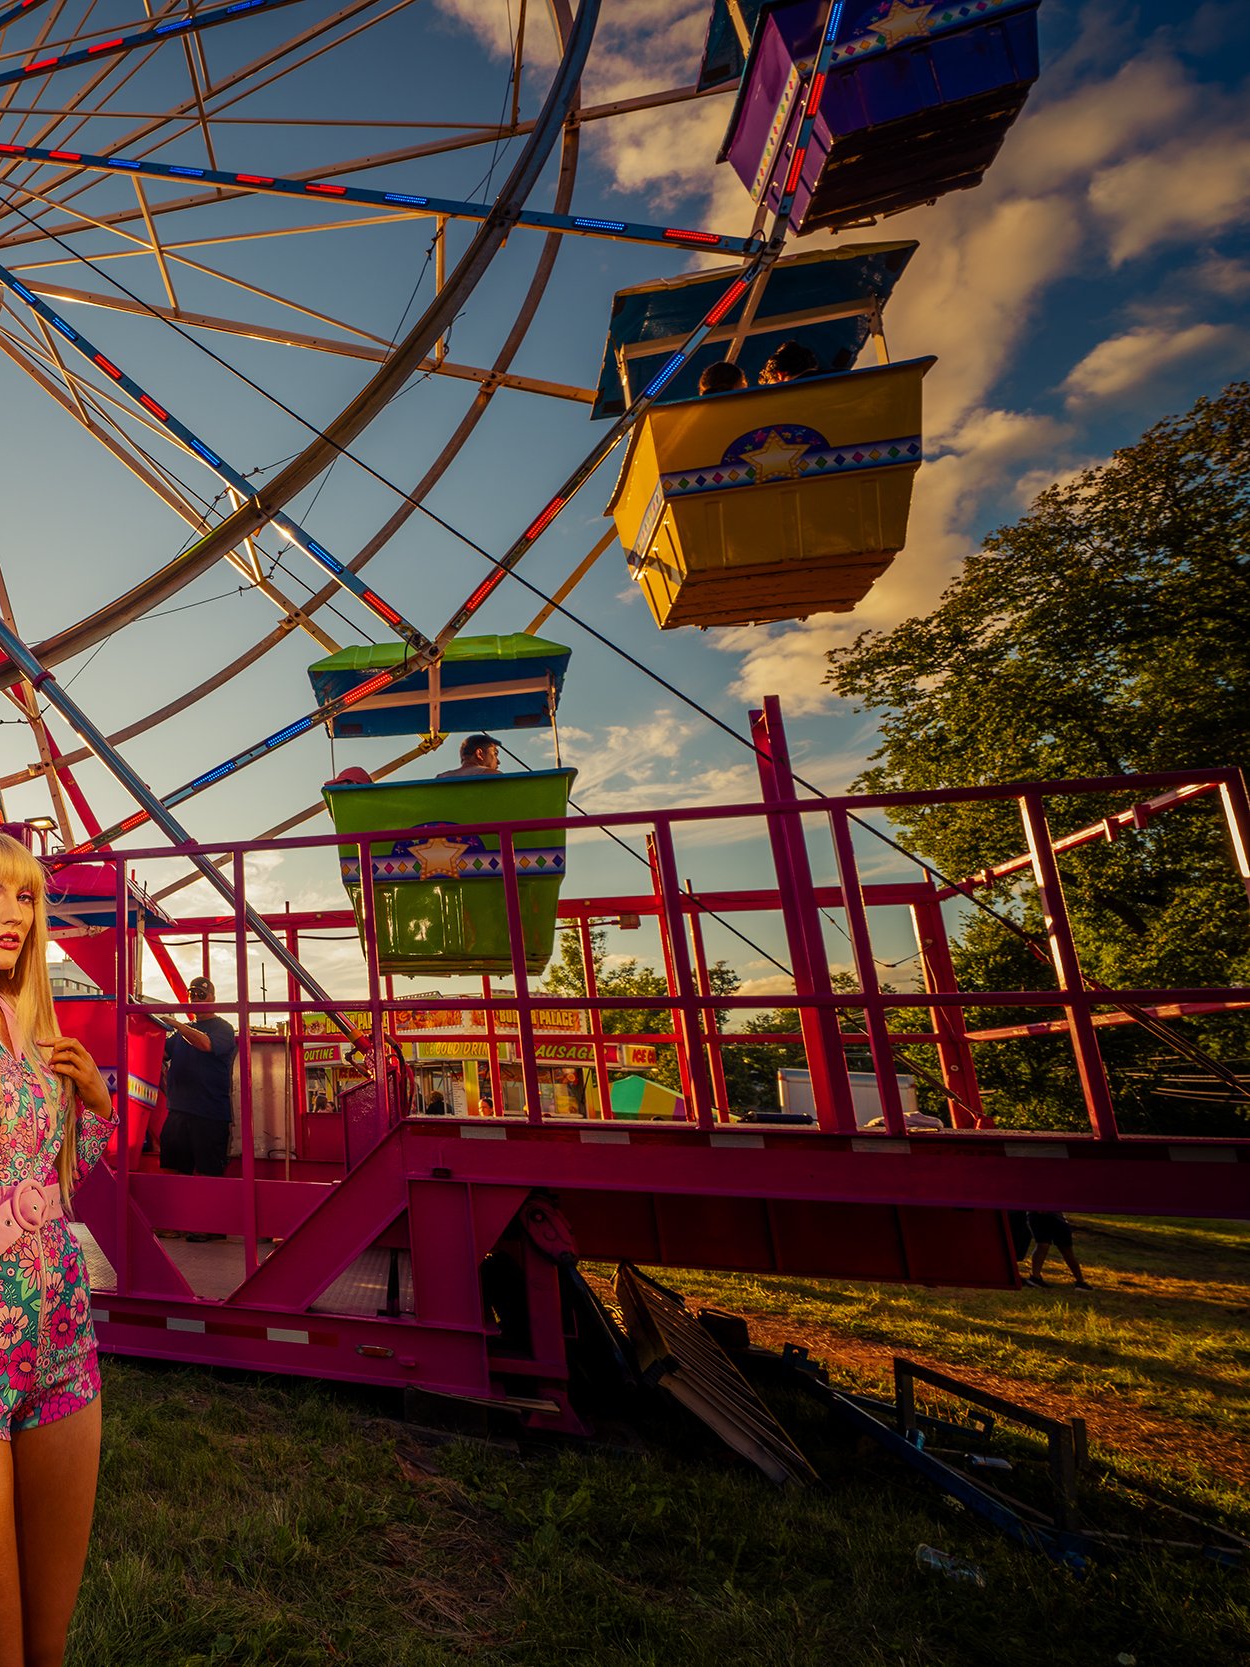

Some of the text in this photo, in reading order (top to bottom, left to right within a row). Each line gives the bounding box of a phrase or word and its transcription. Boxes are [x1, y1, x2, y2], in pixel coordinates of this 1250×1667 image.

[326, 1011, 388, 1033] BUR PALE
[499, 1009, 574, 1027] BURR PALACE
[304, 1048, 334, 1061] OUTINE
[435, 1042, 460, 1056] COLD
[463, 1042, 499, 1056] DRIN
[534, 1045, 607, 1059] AUSAGE
[632, 1048, 647, 1063] ICE
